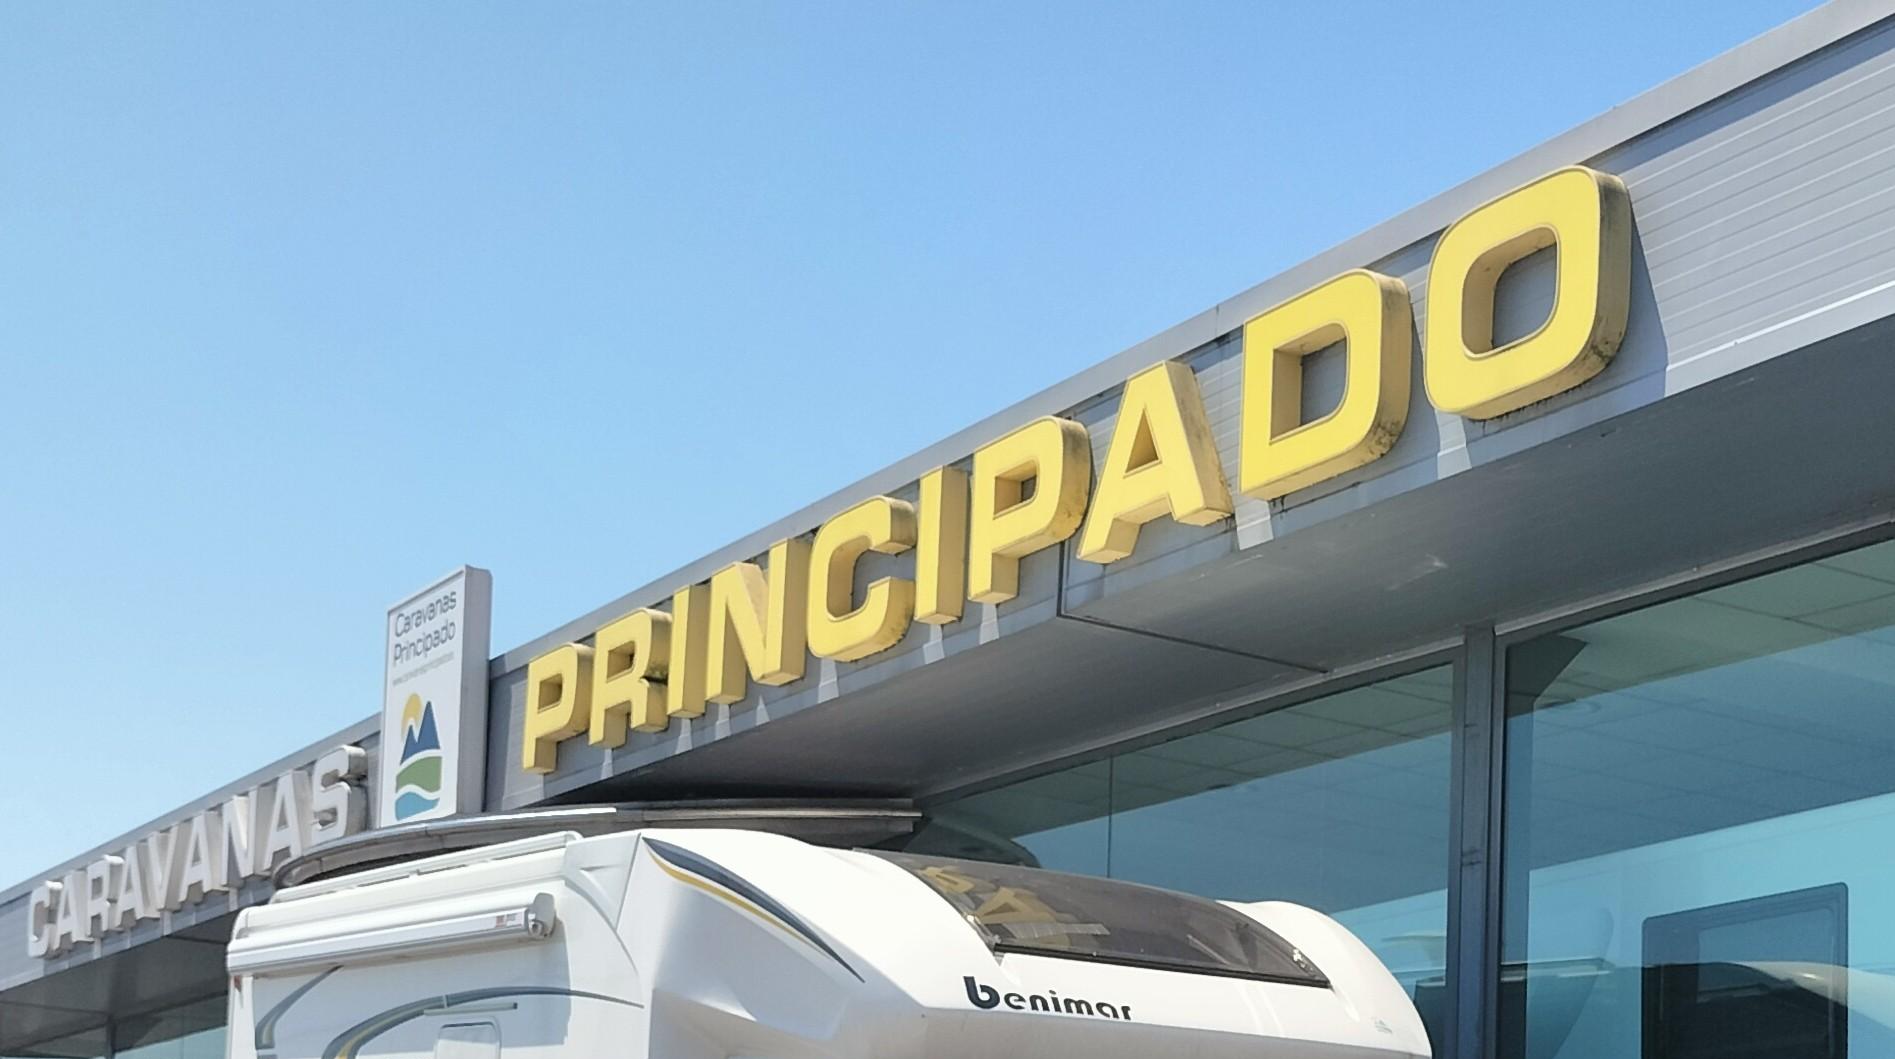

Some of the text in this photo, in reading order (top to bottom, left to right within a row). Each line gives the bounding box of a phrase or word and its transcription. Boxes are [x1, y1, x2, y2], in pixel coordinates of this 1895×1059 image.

[522, 165, 1630, 775] PRINCIPADO
[395, 591, 457, 638] Caravanas
[393, 619, 456, 667] Principado
[28, 744, 368, 958] CARAVANAS
[963, 975, 1132, 1021] benimar
